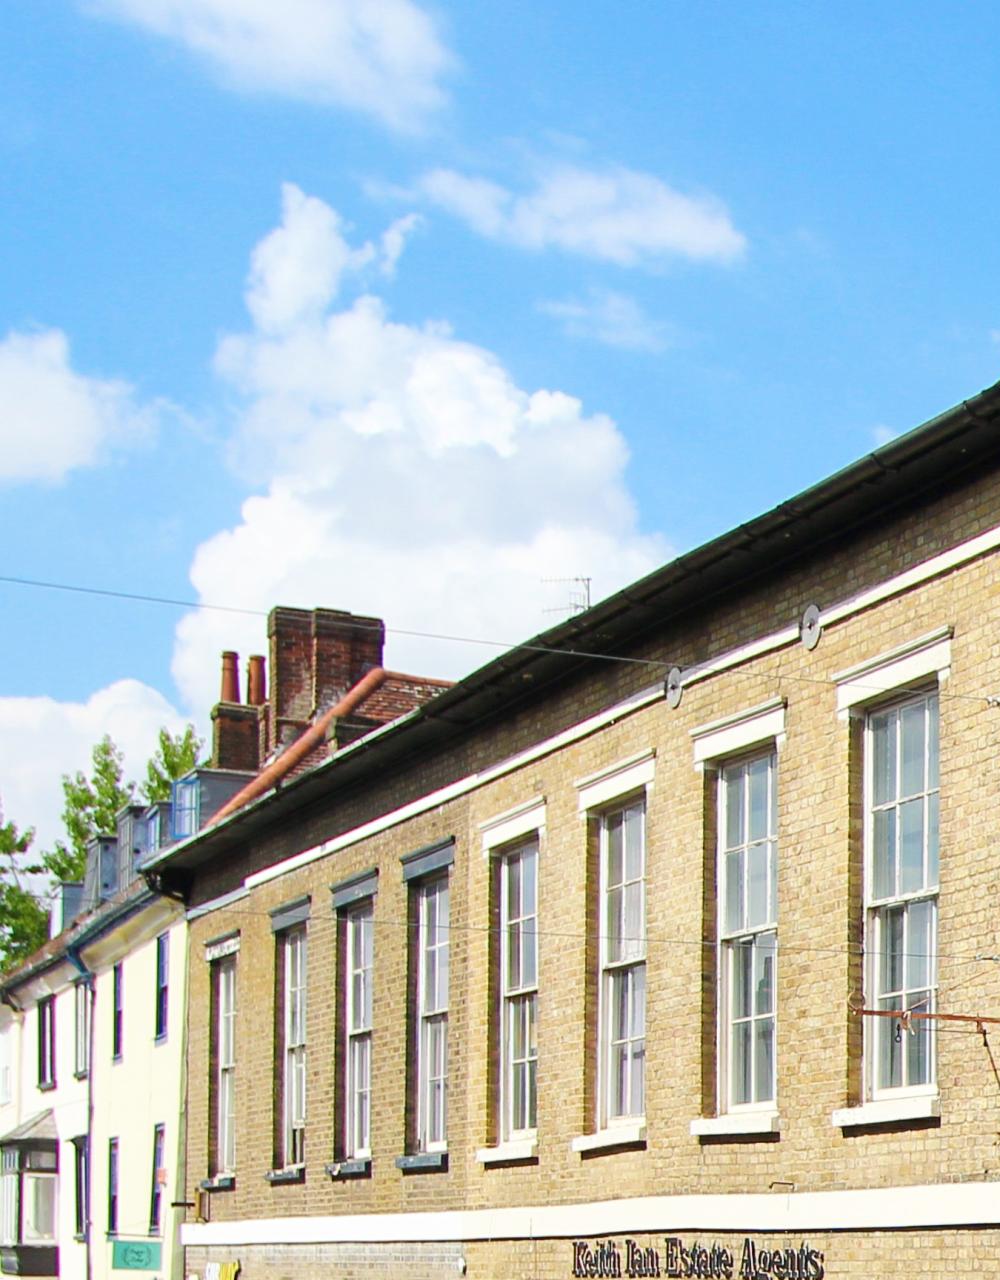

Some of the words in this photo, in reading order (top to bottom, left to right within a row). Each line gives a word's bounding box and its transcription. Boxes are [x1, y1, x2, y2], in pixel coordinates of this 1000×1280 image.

[572, 1241, 621, 1278] Keith
[625, 1239, 660, 1277] Ian
[664, 1237, 734, 1280] Estate
